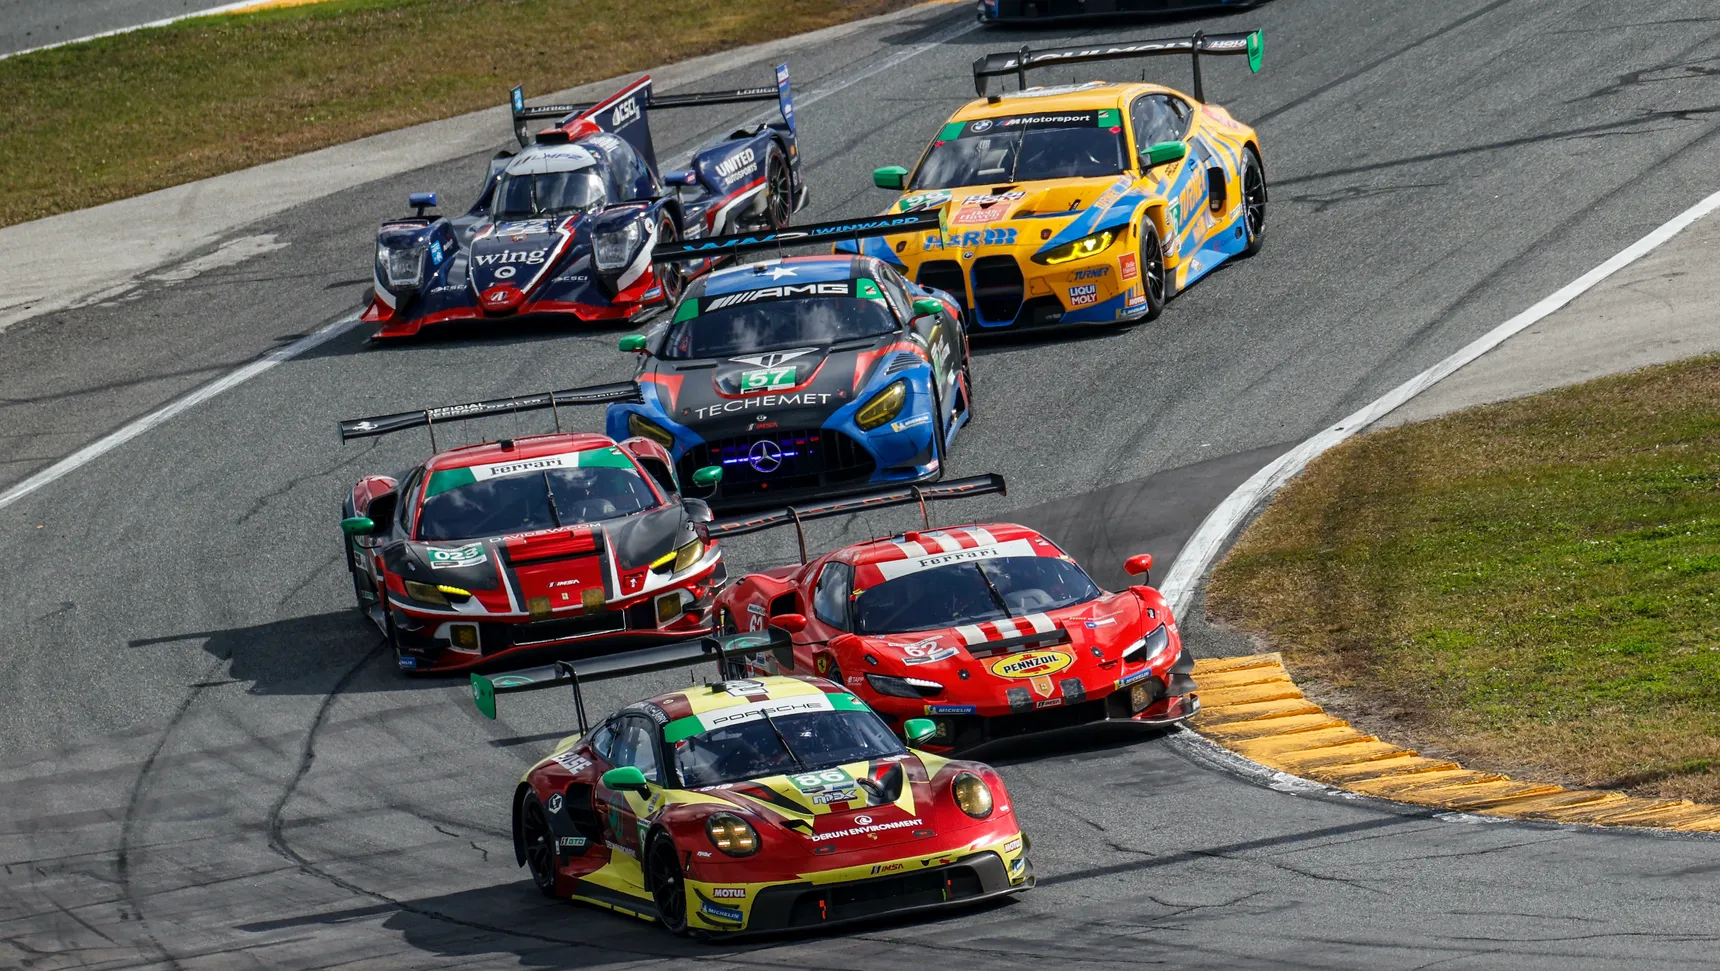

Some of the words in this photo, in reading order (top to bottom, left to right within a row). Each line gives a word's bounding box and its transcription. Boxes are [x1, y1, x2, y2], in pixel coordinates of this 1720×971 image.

[1021, 115, 1091, 125] Motorsport
[715, 148, 755, 176] UNITED
[725, 162, 758, 186] AUTOSPORTS
[815, 217, 919, 234] WINWARD
[475, 250, 545, 266] wing
[1074, 267, 1110, 281] TURNER
[749, 283, 849, 301] AMG
[1070, 284, 1096, 297] LIQUI
[1071, 294, 1097, 306] MOLY
[748, 370, 791, 387] 57
[423, 402, 487, 415] OFFICIAL
[695, 393, 832, 420] TECHEMET
[489, 457, 563, 476] Ferrari
[433, 546, 479, 561] 023
[918, 547, 999, 568] Ferrari
[556, 579, 580, 587] IMSA
[903, 641, 944, 657] 62
[1003, 654, 1060, 674] PENNZOIL
[712, 702, 823, 725] PORSCHE
[794, 770, 846, 787] 86
[811, 829, 849, 842] DERUN
[849, 818, 923, 836] ENVIRONMENT
[881, 864, 905, 872] IMSA
[714, 889, 746, 898] MOTUL
[708, 907, 740, 919] MICHELIN
